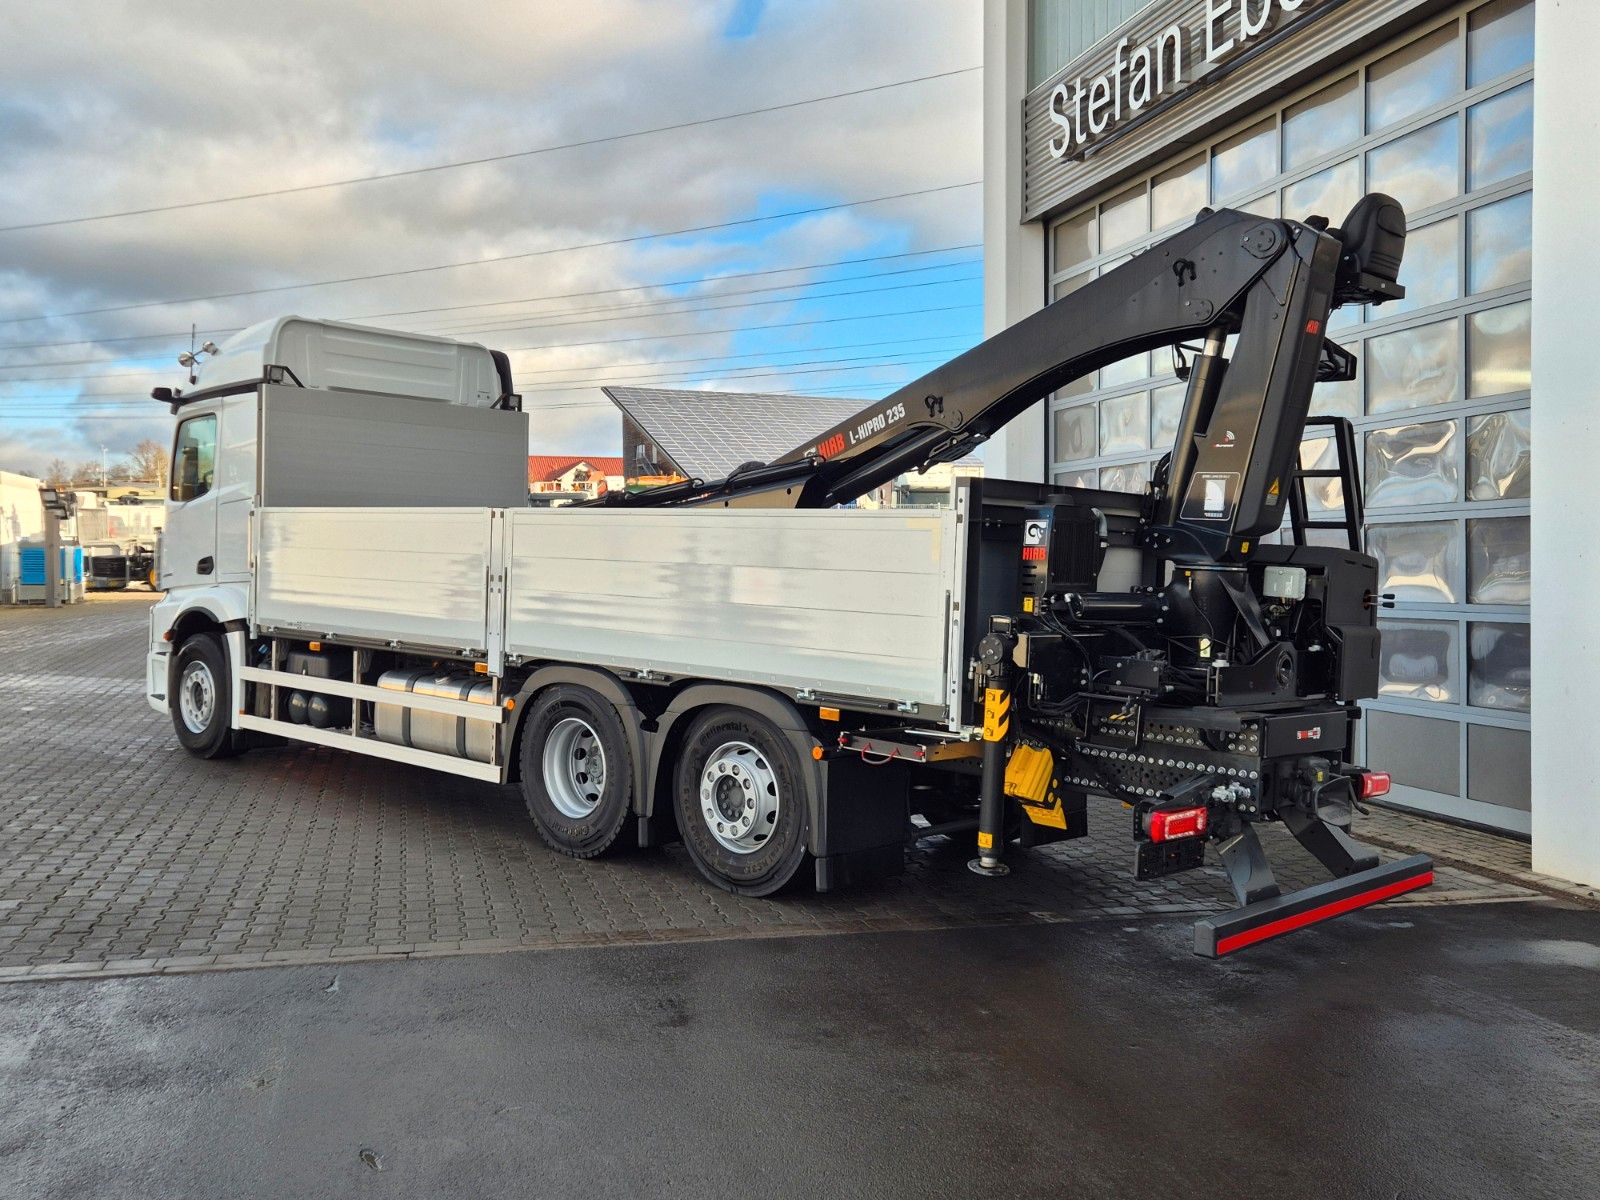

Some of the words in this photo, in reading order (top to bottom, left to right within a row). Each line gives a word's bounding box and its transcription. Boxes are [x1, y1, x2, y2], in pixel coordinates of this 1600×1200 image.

[1048, 23, 1183, 159] Stefan
[849, 414, 885, 444] L-HIPRO
[886, 402, 906, 424] 235
[1022, 546, 1046, 561] HIAB
